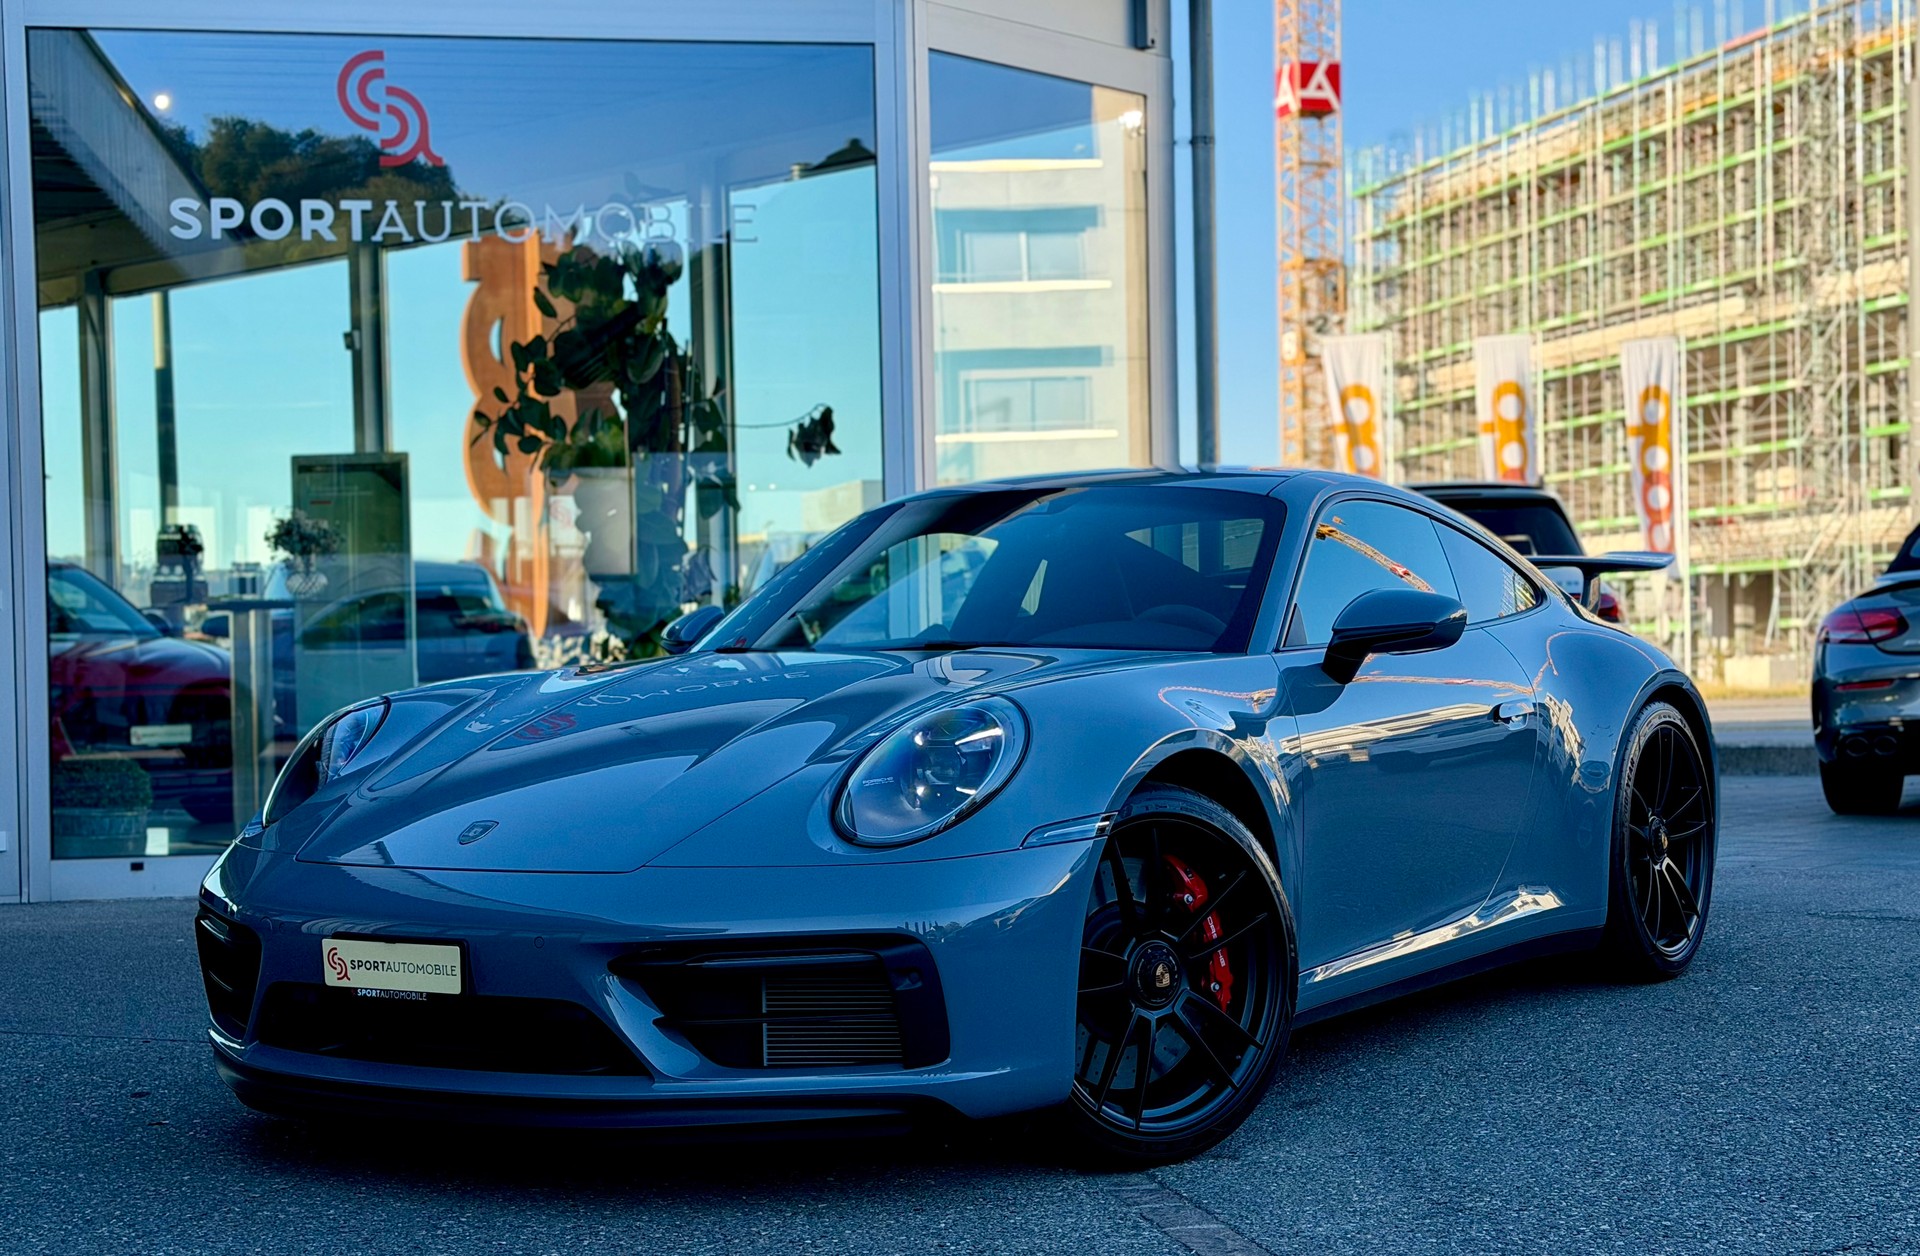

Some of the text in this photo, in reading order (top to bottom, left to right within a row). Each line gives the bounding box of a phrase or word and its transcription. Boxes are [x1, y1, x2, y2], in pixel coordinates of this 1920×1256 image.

[169, 197, 758, 243] SPORTAUTOMOBILE
[350, 958, 458, 977] SPORTAUTOMOBILE
[357, 988, 427, 1001] SPORTAUTOMOBILE
